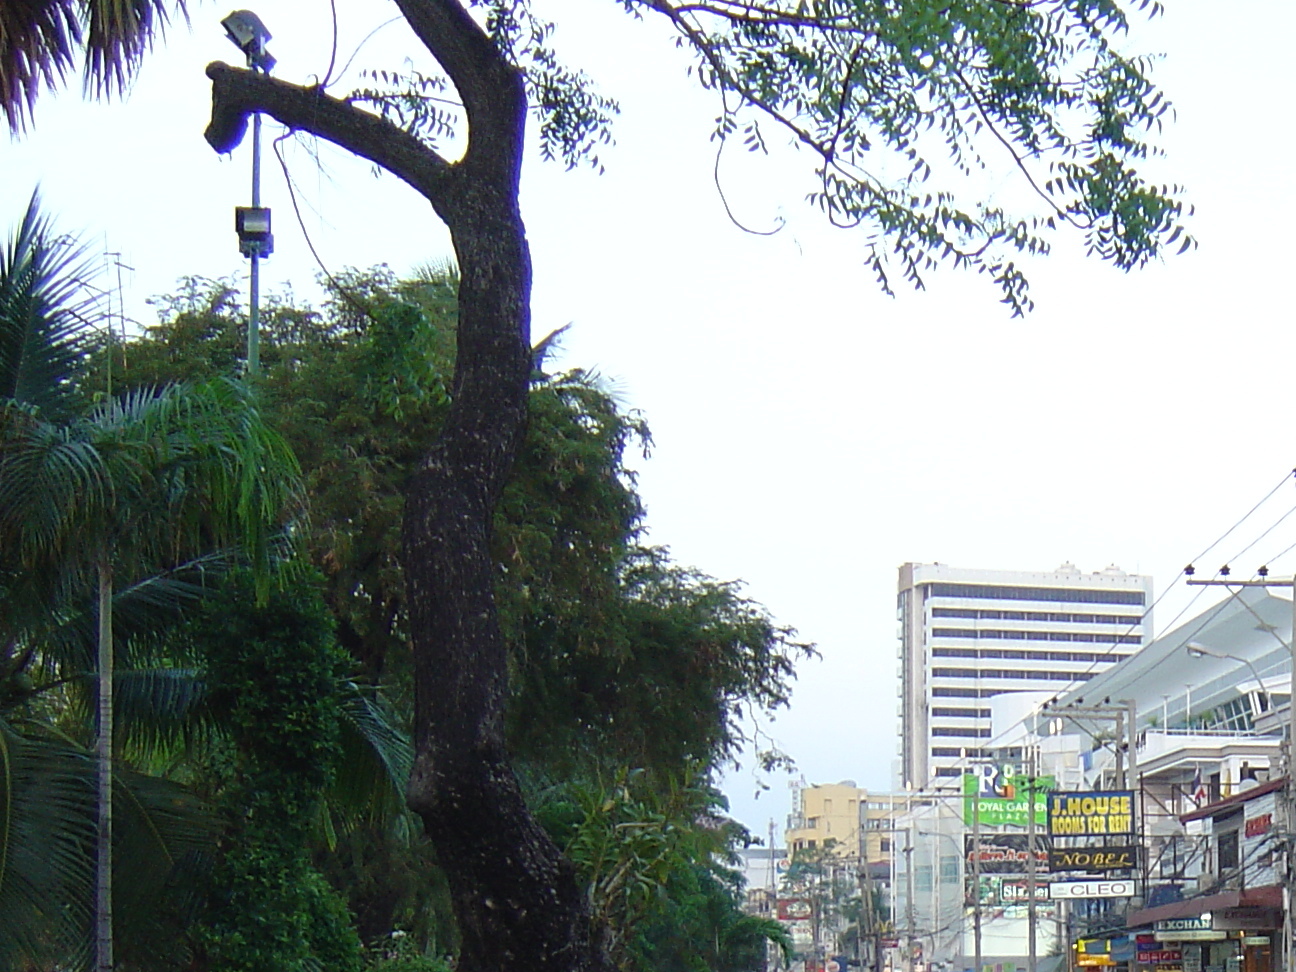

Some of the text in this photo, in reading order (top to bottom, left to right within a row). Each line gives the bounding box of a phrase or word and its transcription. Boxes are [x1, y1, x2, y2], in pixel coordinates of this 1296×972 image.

[971, 802, 1048, 812] OYAL GAREN
[1051, 797, 1132, 816] J.HOUSE
[1052, 814, 1132, 834] ROOMS FOR RENT
[1055, 852, 1133, 866] NOBEL
[1070, 882, 1127, 896] CLEO
